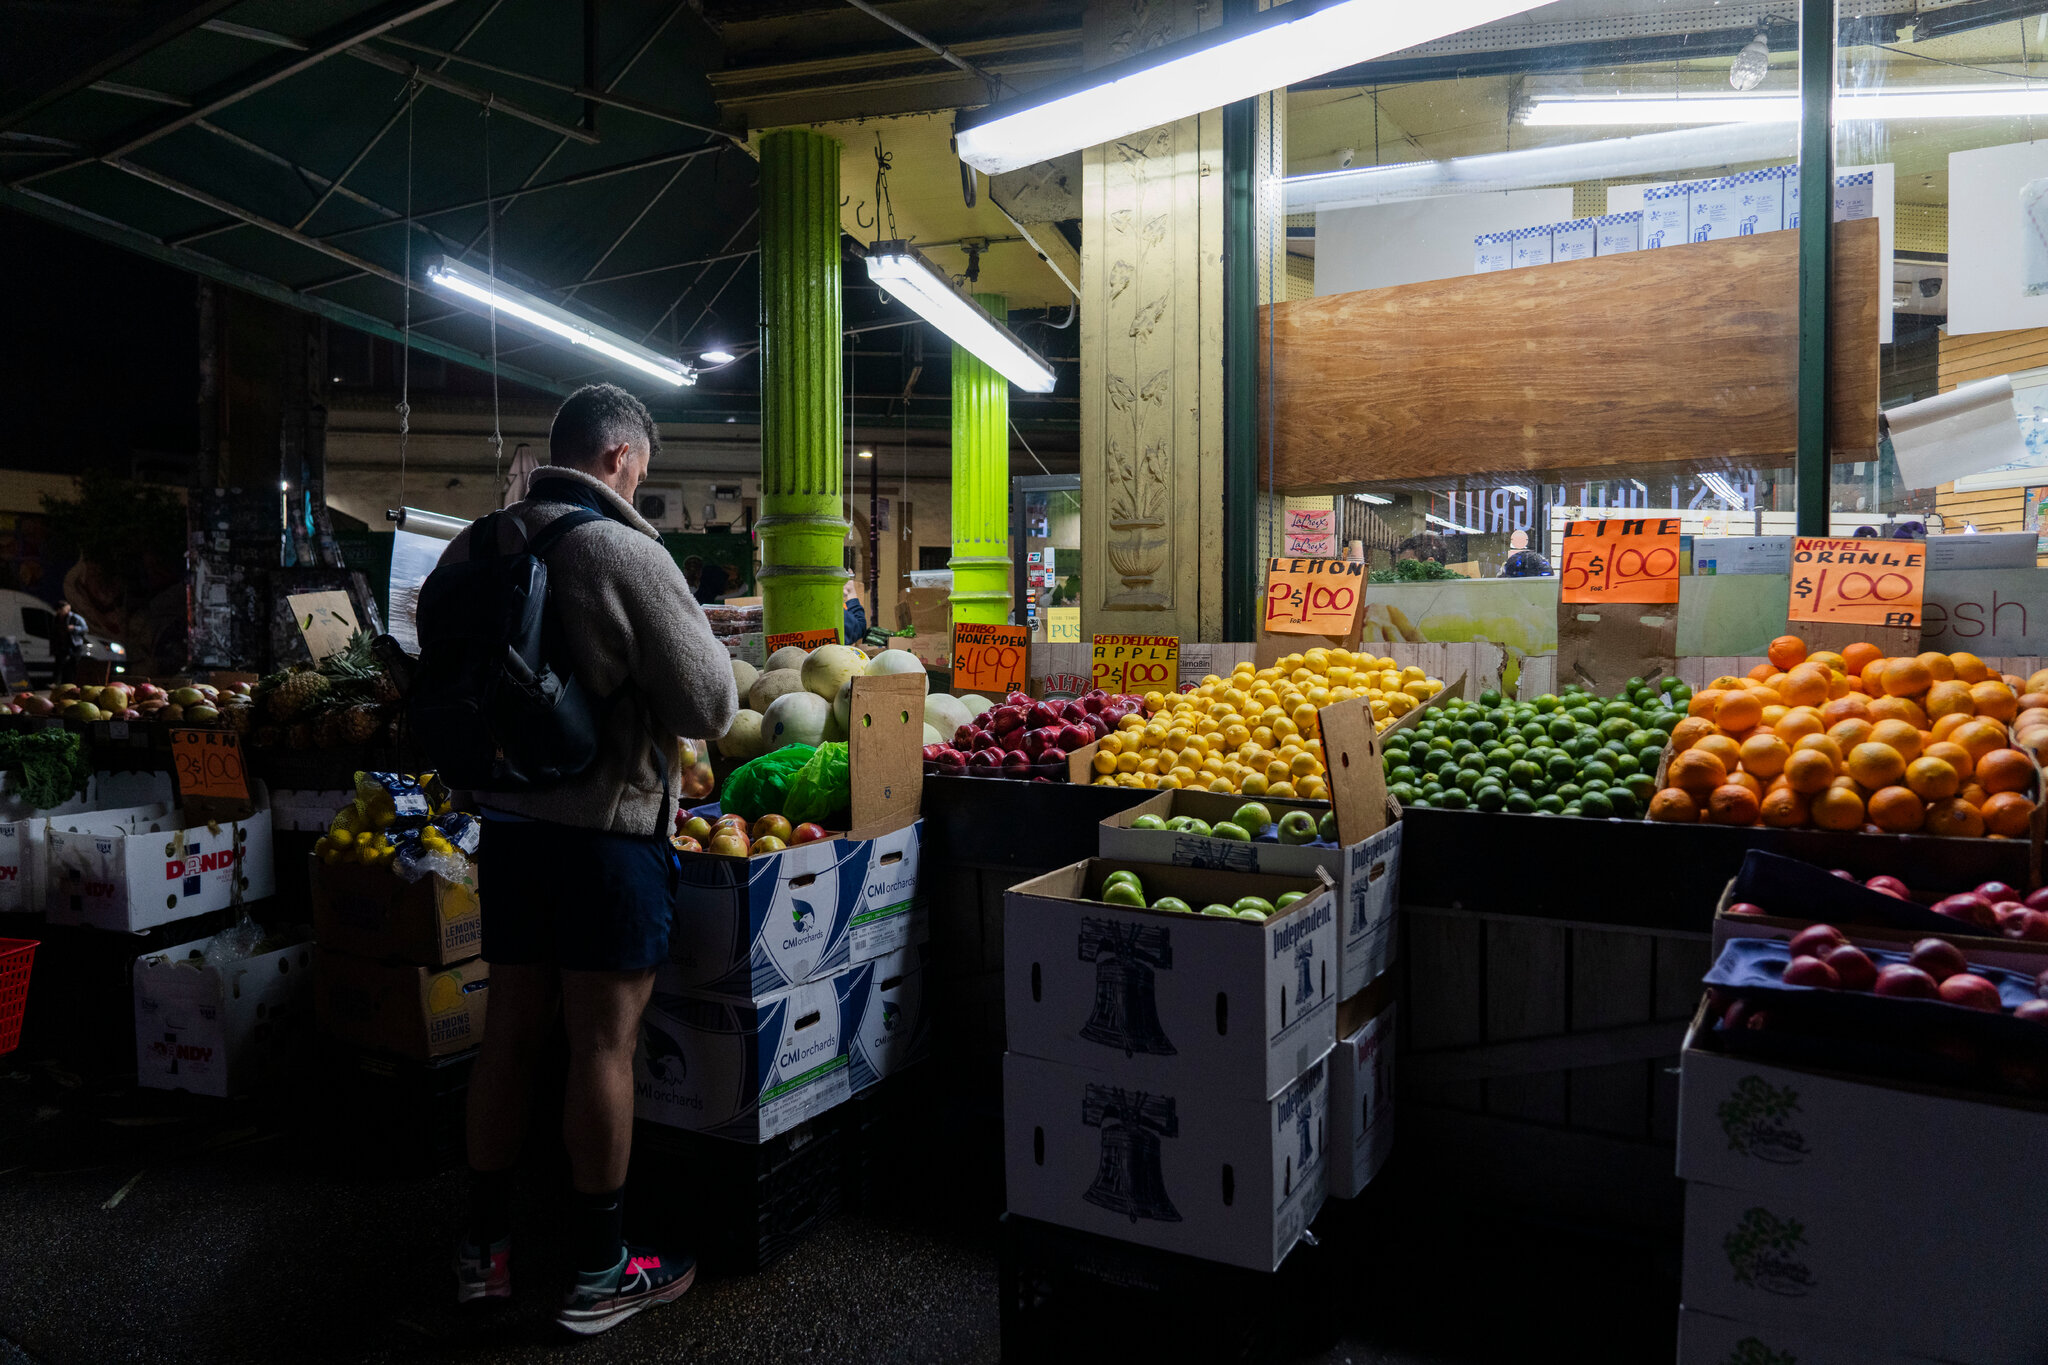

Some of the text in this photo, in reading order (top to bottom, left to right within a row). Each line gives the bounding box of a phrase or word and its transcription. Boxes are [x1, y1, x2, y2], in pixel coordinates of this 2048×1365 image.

[1563, 519, 1680, 538] LIME
[1795, 539, 1870, 552] NAVEL
[1270, 558, 1363, 576] LEMON
[1794, 550, 1922, 567] ORANGE
[957, 623, 997, 634] JUMBO
[1884, 612, 1915, 626] EA
[769, 632, 804, 644] JUMBO
[956, 633, 1027, 648] HONEYDEW
[1094, 635, 1178, 648] RED DELICIOUS
[1094, 646, 1177, 660] APPLE
[955, 646, 1021, 687] $4.99
[170, 731, 235, 748] CORN
[1351, 826, 1401, 875] Independent
[867, 873, 917, 897] CMI orchards
[445, 918, 481, 938] LEMONS
[1273, 900, 1332, 959] Independent
[445, 929, 482, 949] CITRONS
[782, 929, 824, 950] CMI orchards
[430, 1013, 470, 1033] LEMONS
[431, 1024, 471, 1044] CITRONS
[780, 1032, 836, 1068] CMI orchards
[653, 1088, 704, 1111] orchards
